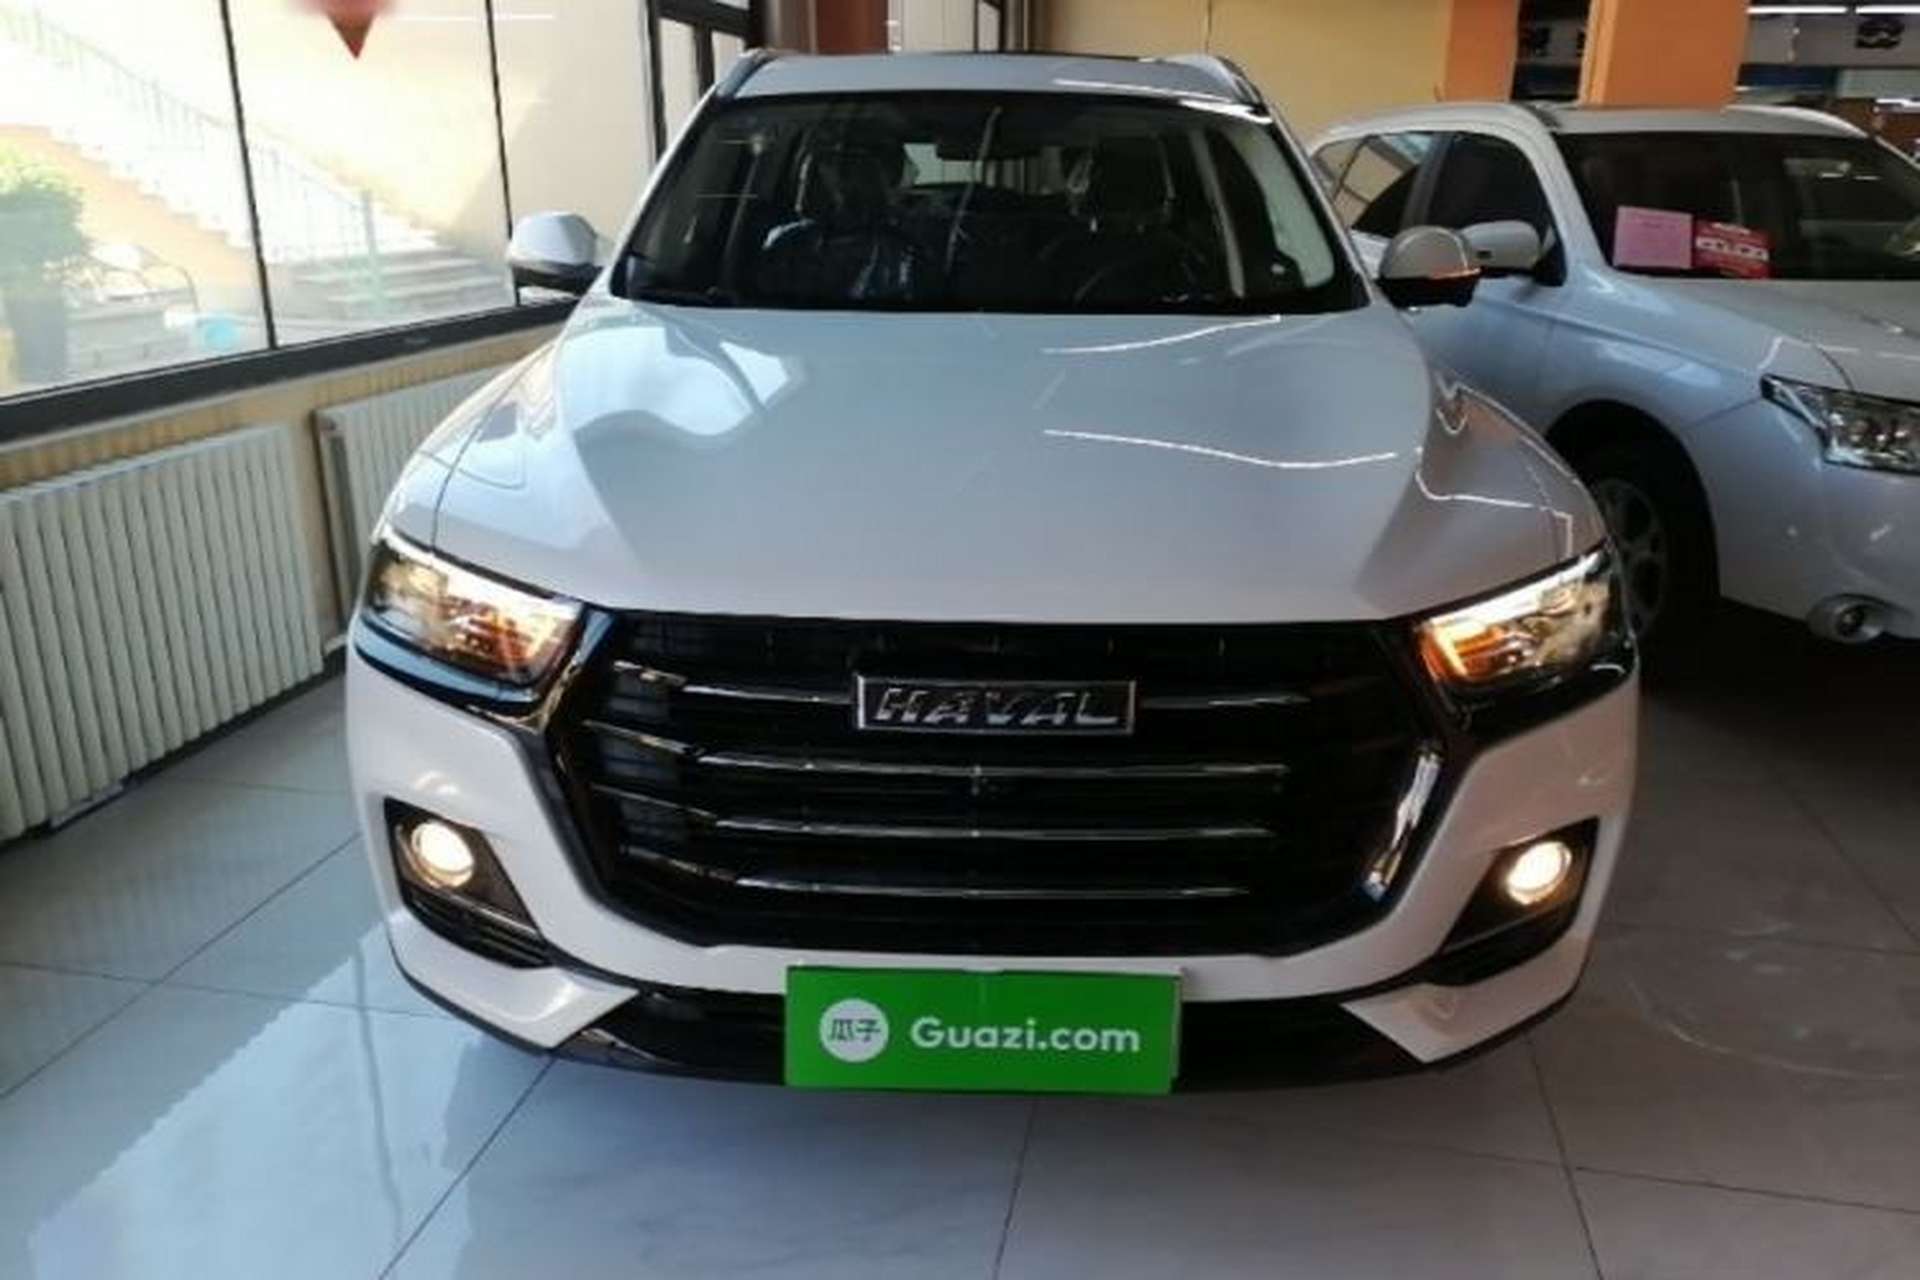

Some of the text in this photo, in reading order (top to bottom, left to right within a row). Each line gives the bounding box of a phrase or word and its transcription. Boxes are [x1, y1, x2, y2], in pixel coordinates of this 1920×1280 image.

[875, 687, 1118, 725] HAVAL
[830, 1018, 881, 1043] 瓜子
[910, 1016, 1140, 1052] Guazi.com
